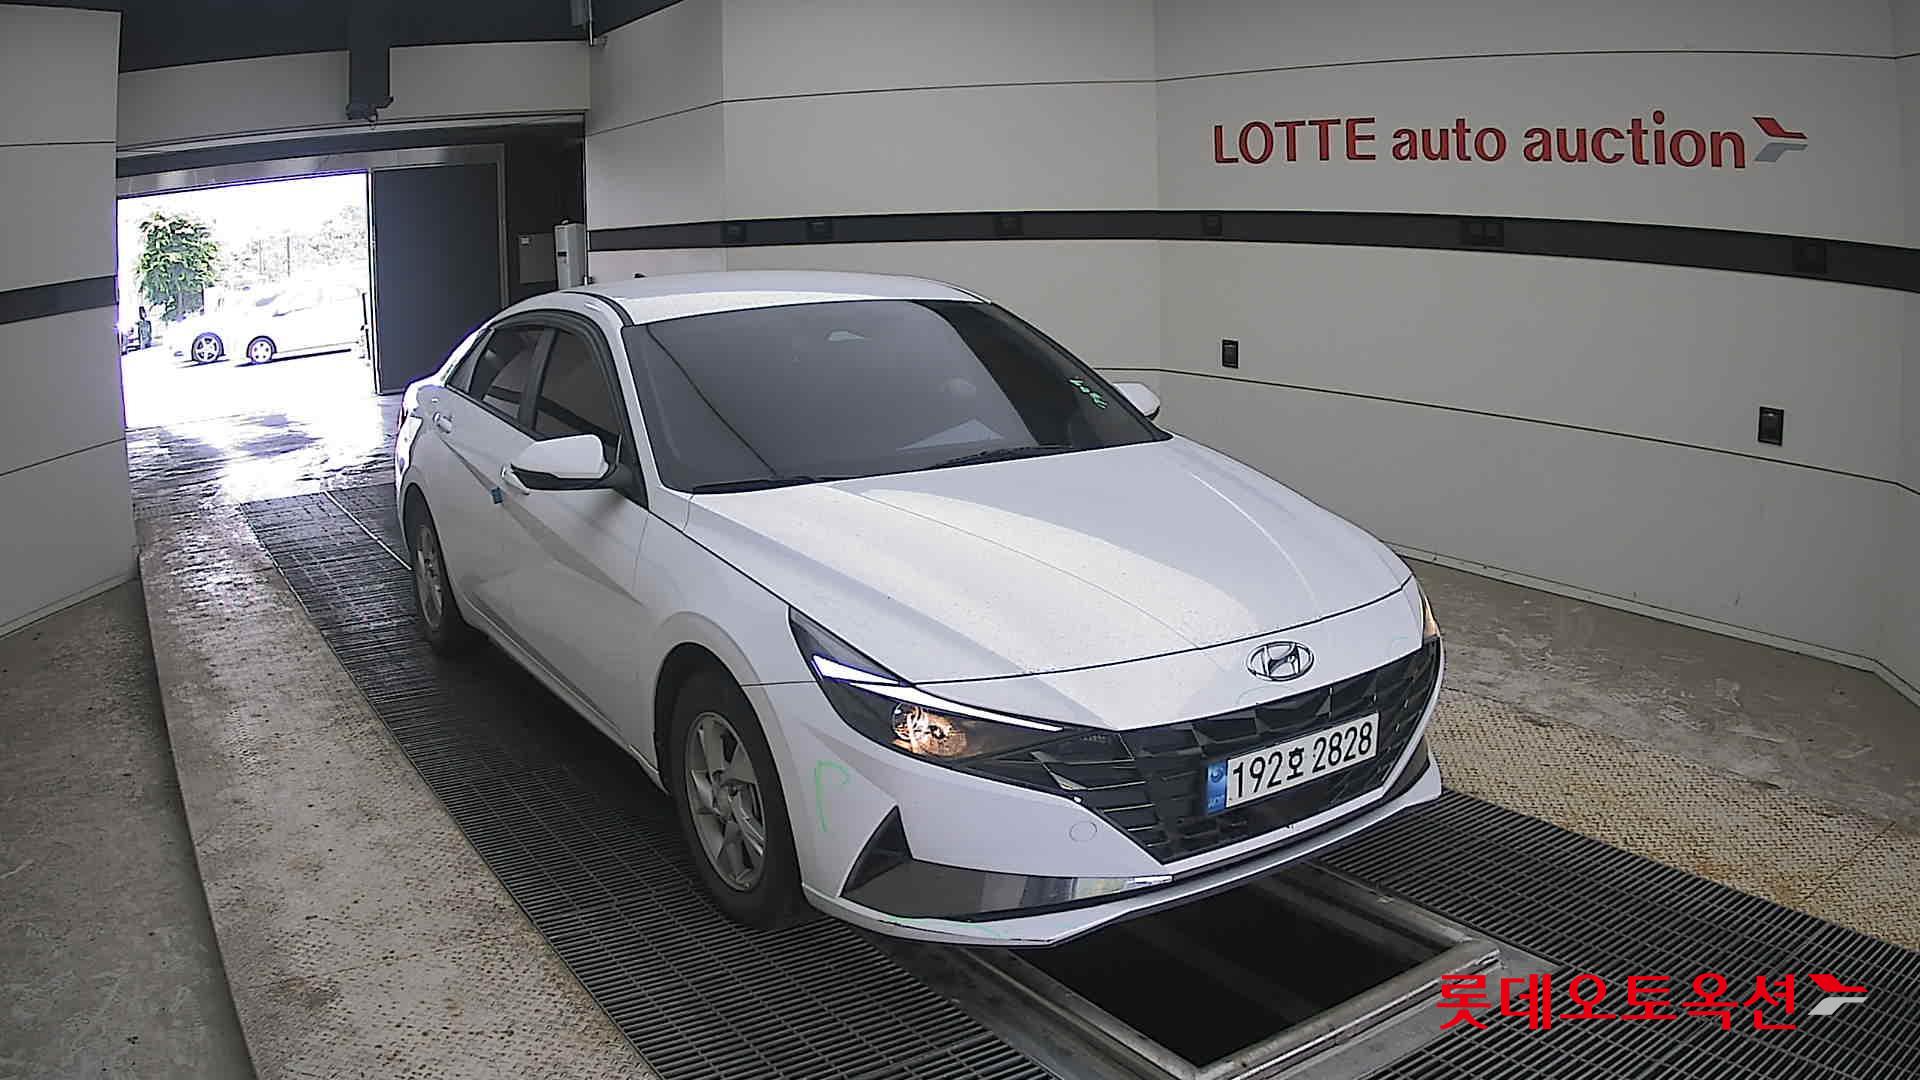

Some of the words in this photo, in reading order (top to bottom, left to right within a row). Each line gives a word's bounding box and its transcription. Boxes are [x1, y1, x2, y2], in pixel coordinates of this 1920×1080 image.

[1213, 117, 1376, 164] LOTTE
[1391, 119, 1507, 161] auto
[1523, 110, 1746, 169] auction
[1232, 747, 1305, 798] 192호
[1311, 721, 1373, 773] 2828
